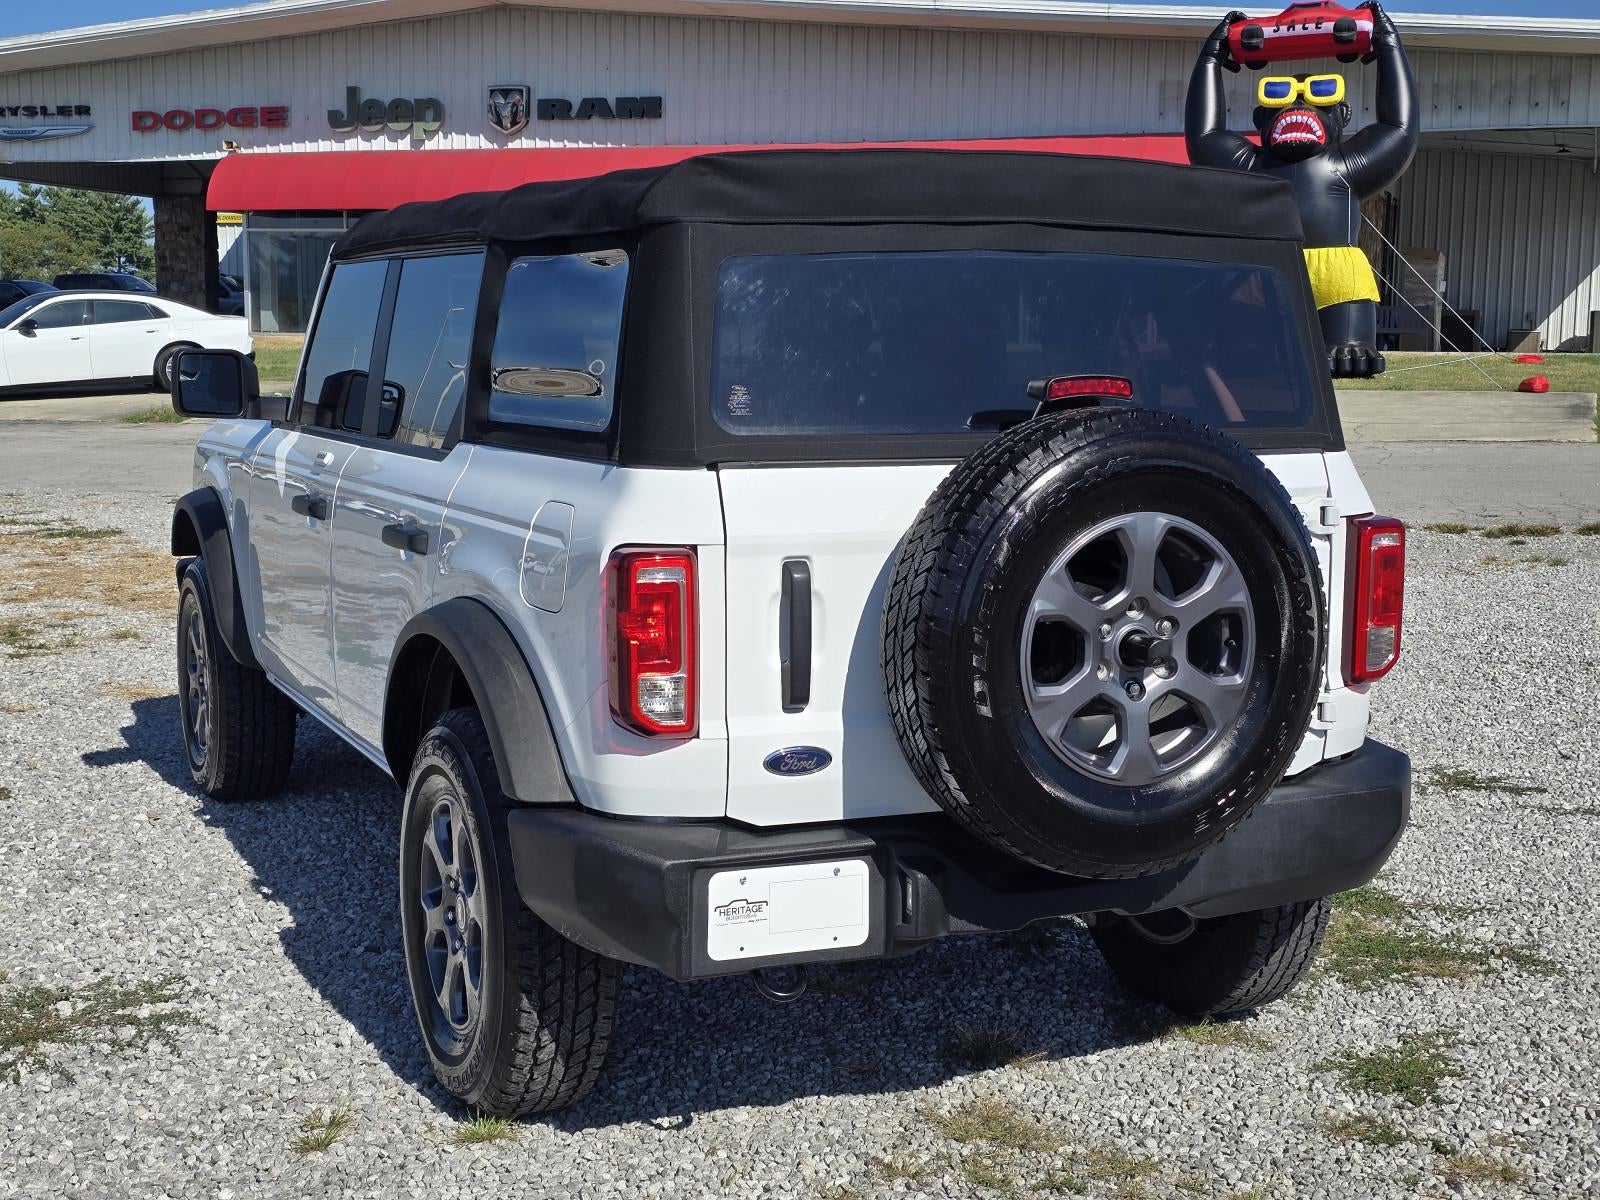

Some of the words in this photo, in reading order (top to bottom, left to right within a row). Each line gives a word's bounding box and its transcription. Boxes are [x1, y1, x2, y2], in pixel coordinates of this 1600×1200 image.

[1272, 16, 1325, 33] SALE
[131, 105, 289, 131] DODGE
[327, 86, 445, 140] Jeep
[537, 95, 663, 120] RAM
[719, 904, 763, 917] HERITAGE
